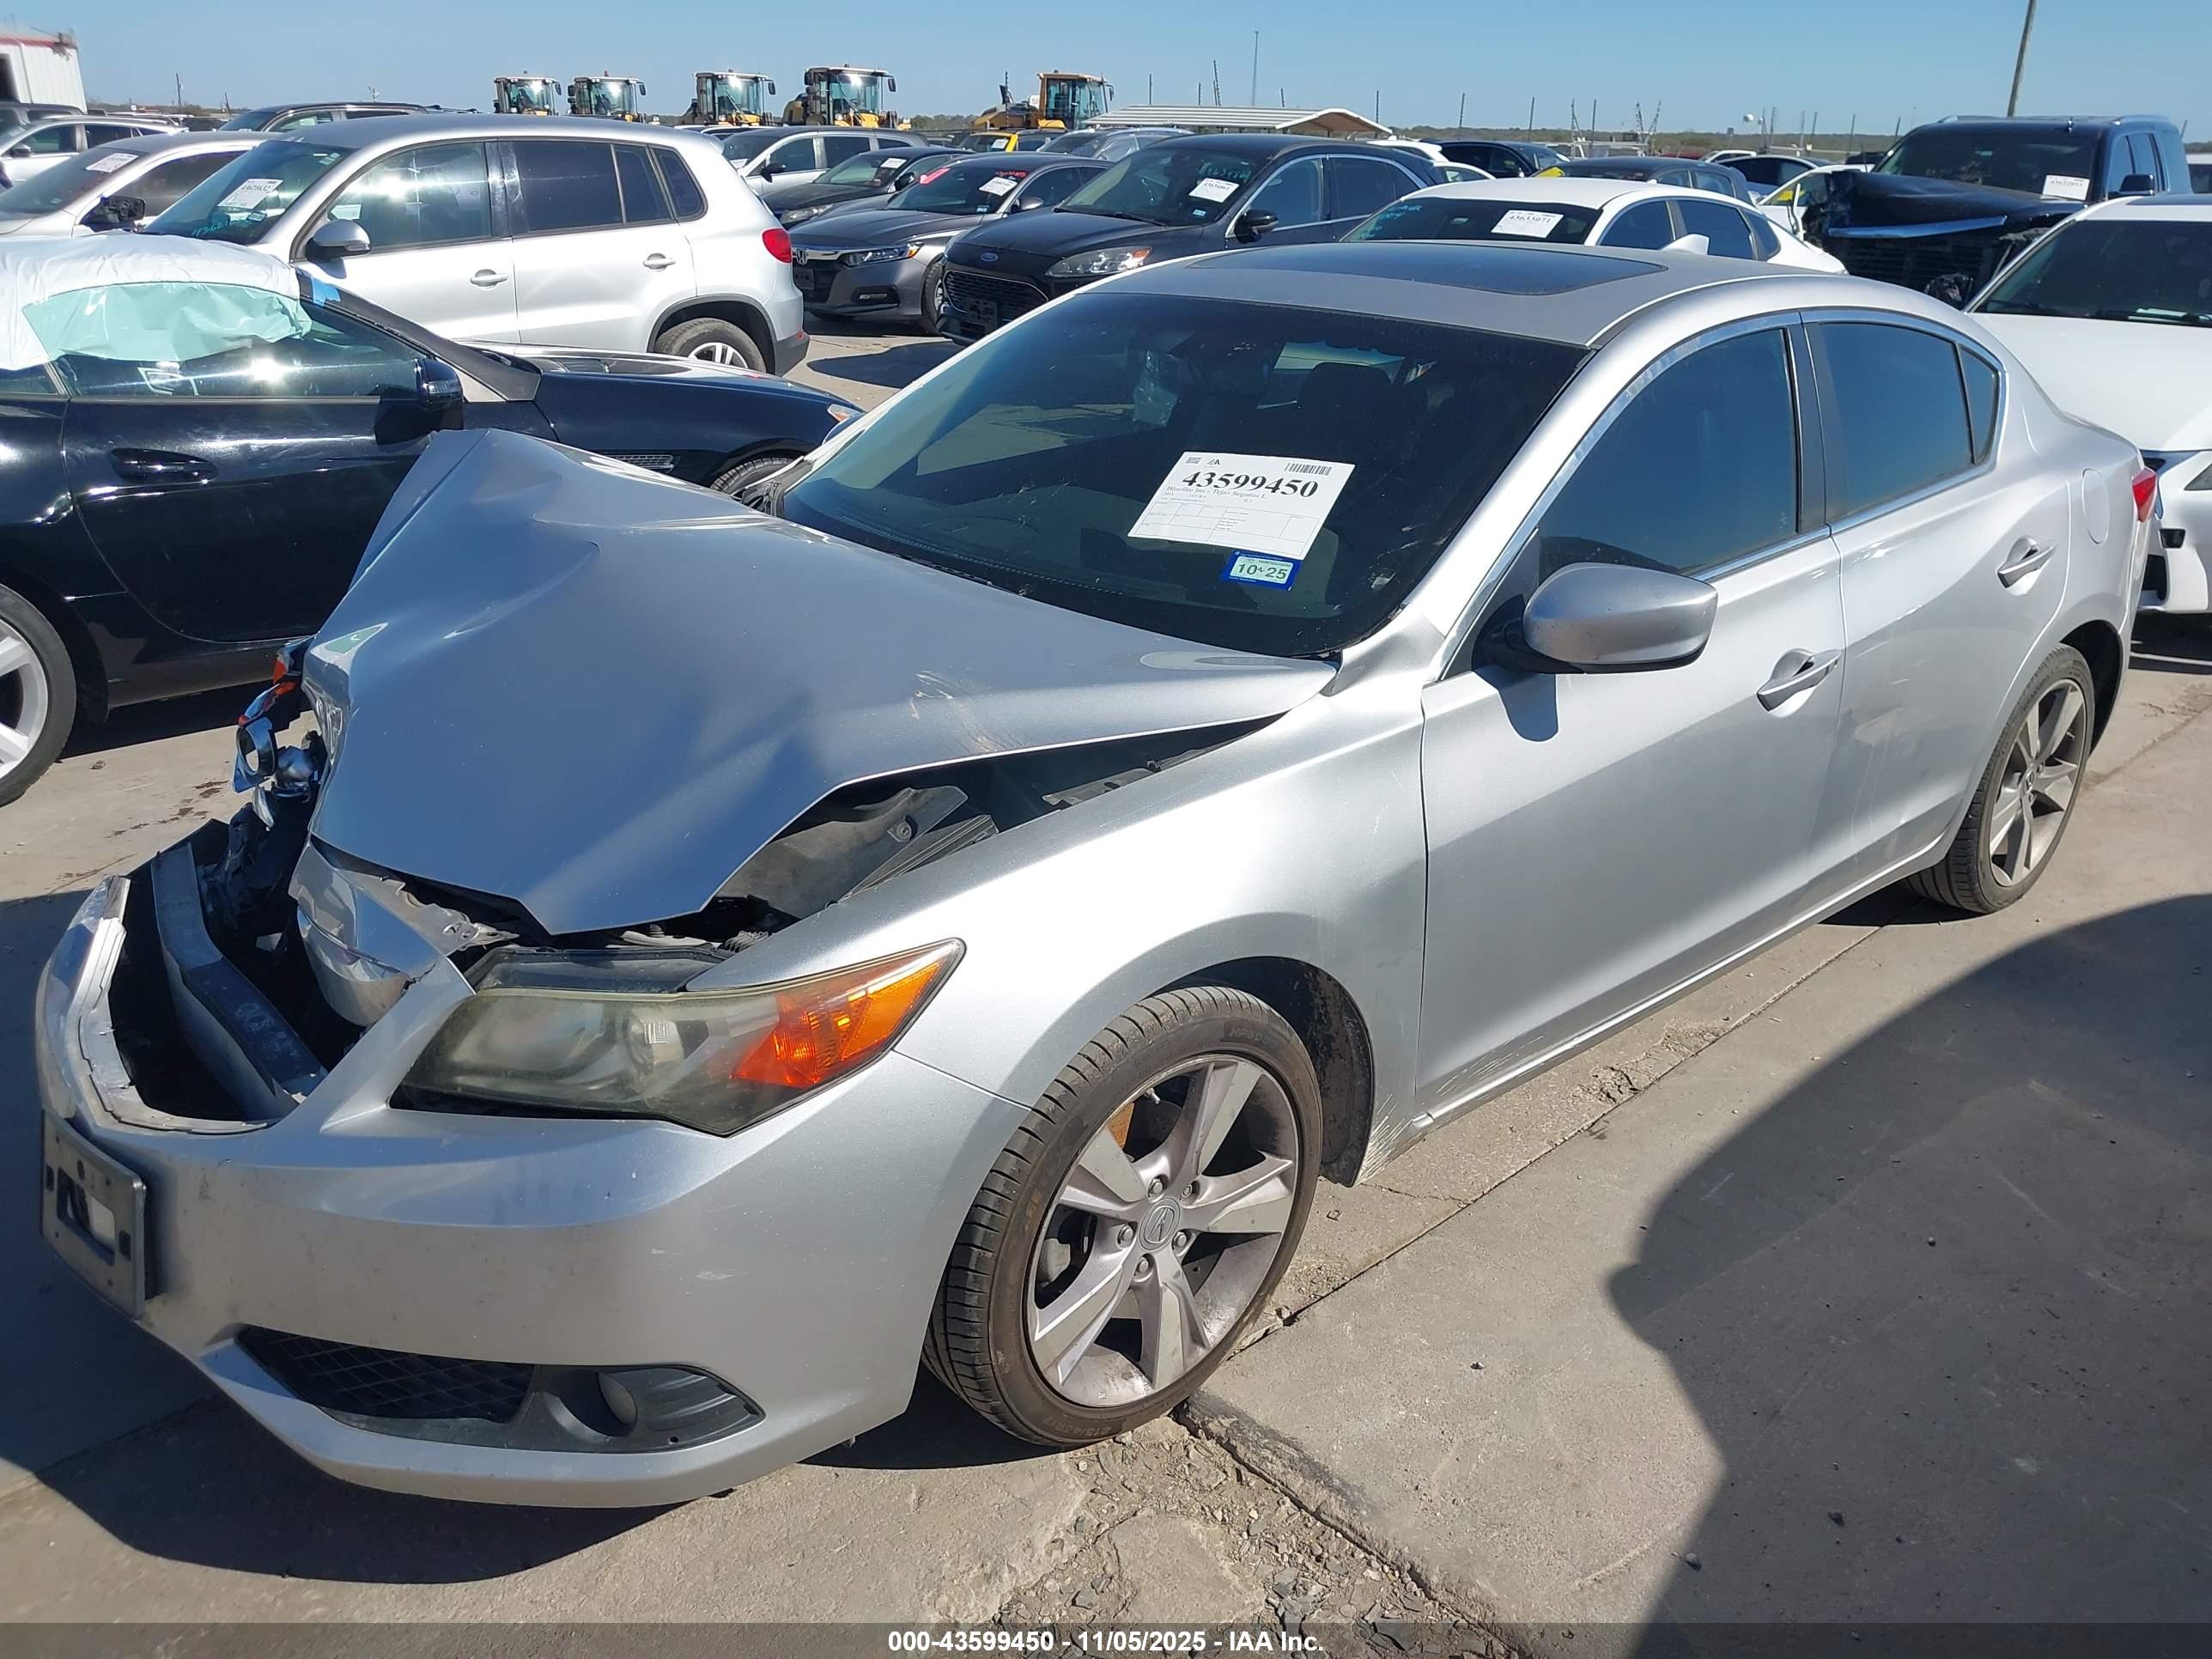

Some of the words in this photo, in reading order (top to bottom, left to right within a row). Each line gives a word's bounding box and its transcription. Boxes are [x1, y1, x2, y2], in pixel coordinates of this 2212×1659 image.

[1182, 471, 1319, 498] 43599450
[1238, 563, 1258, 575] 10
[1265, 567, 1288, 580] 25
